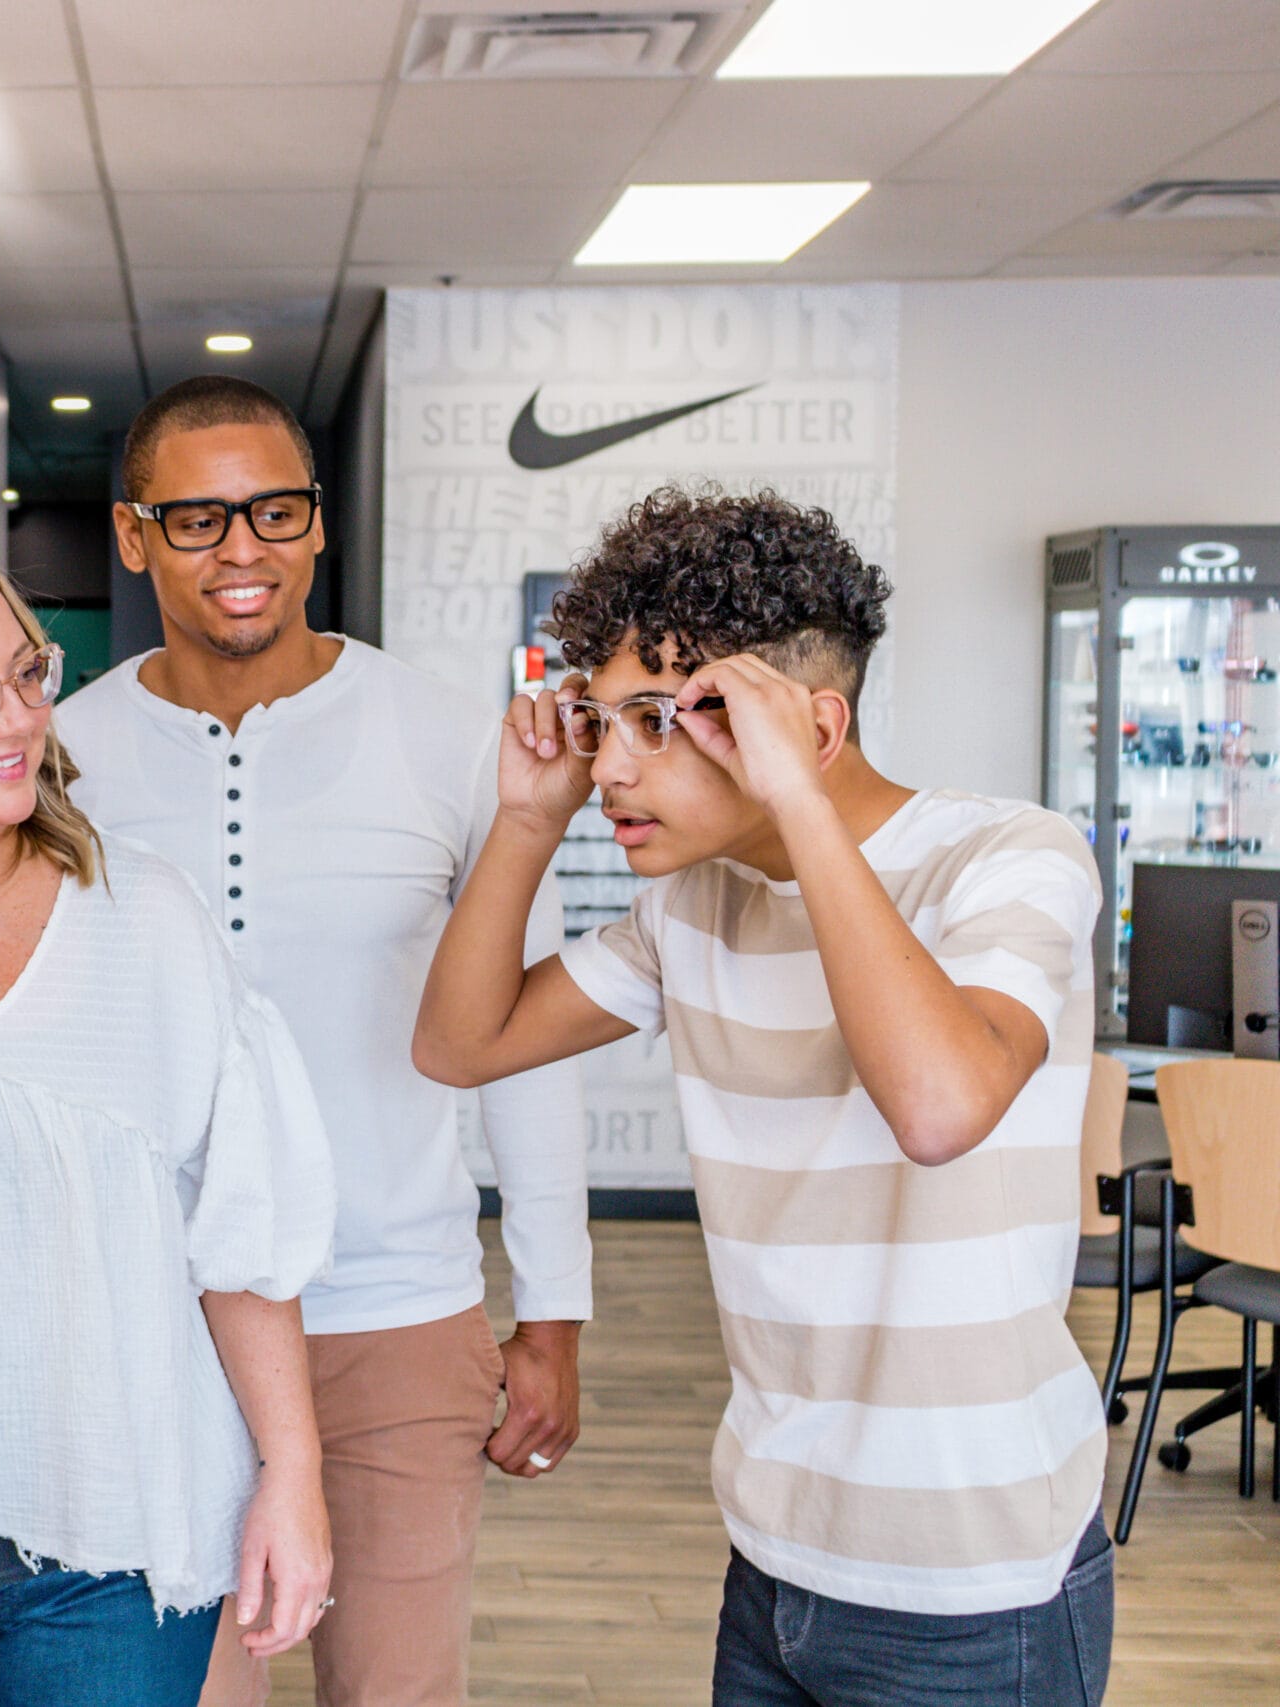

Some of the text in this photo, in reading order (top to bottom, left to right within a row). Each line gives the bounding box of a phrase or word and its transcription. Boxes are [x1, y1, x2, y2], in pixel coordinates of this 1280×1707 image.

[627, 287, 751, 374] DO
[421, 401, 502, 447] SEE
[683, 400, 854, 445] BETTER
[1160, 565, 1257, 583] OAKLEY
